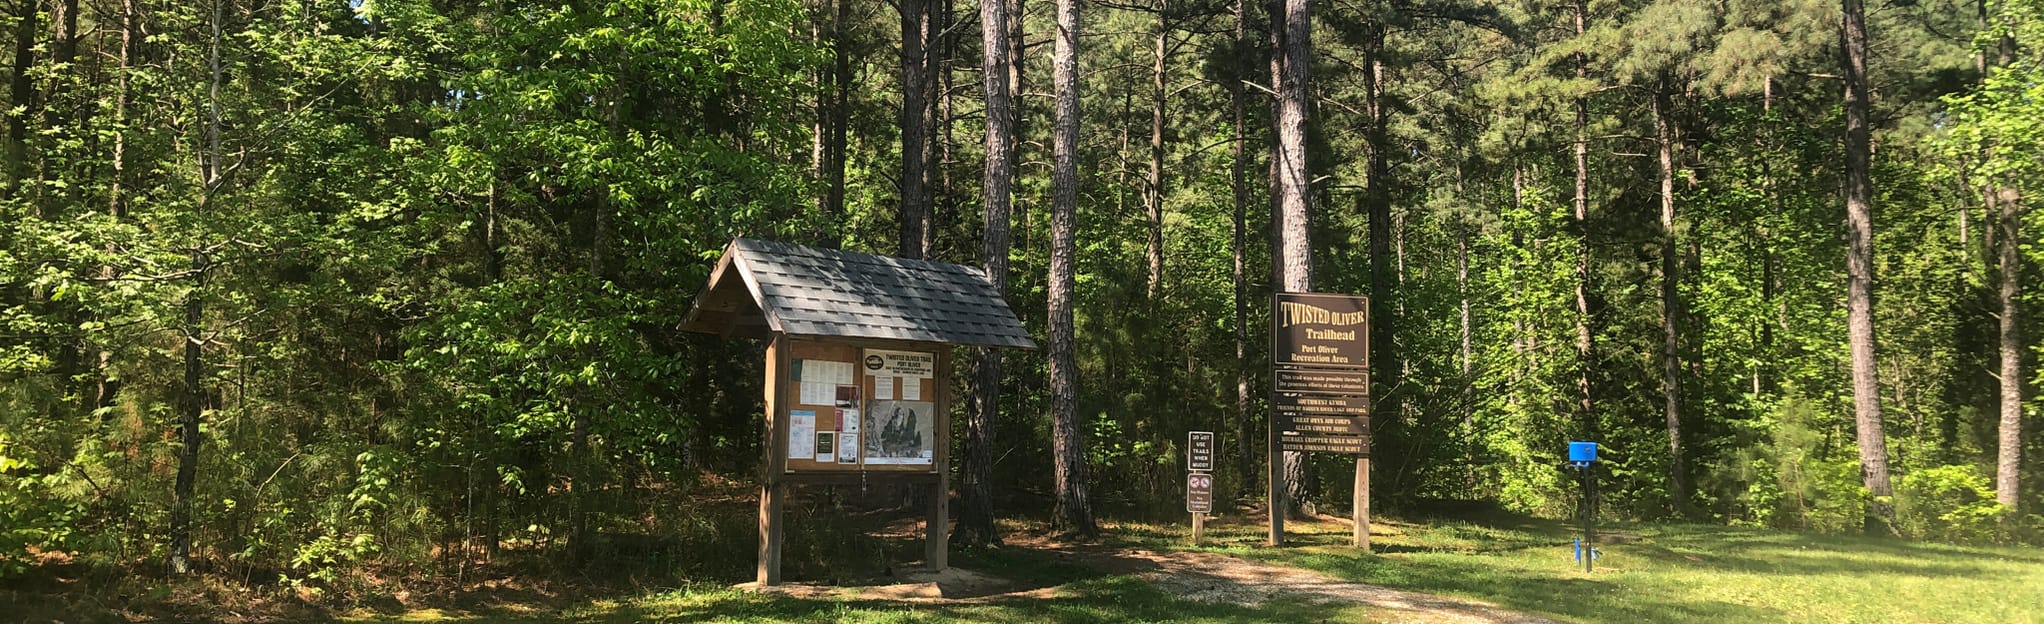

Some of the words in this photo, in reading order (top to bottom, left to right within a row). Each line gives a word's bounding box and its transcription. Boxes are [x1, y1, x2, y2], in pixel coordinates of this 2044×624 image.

[1281, 302, 1330, 327] TWISTED
[1331, 311, 1364, 326] OLIVER
[1306, 328, 1355, 340] Trailhead
[1301, 345, 1316, 353] Port
[1318, 345, 1338, 354] Oliver
[1292, 353, 1330, 363] Recreation
[1331, 355, 1348, 363] Area
